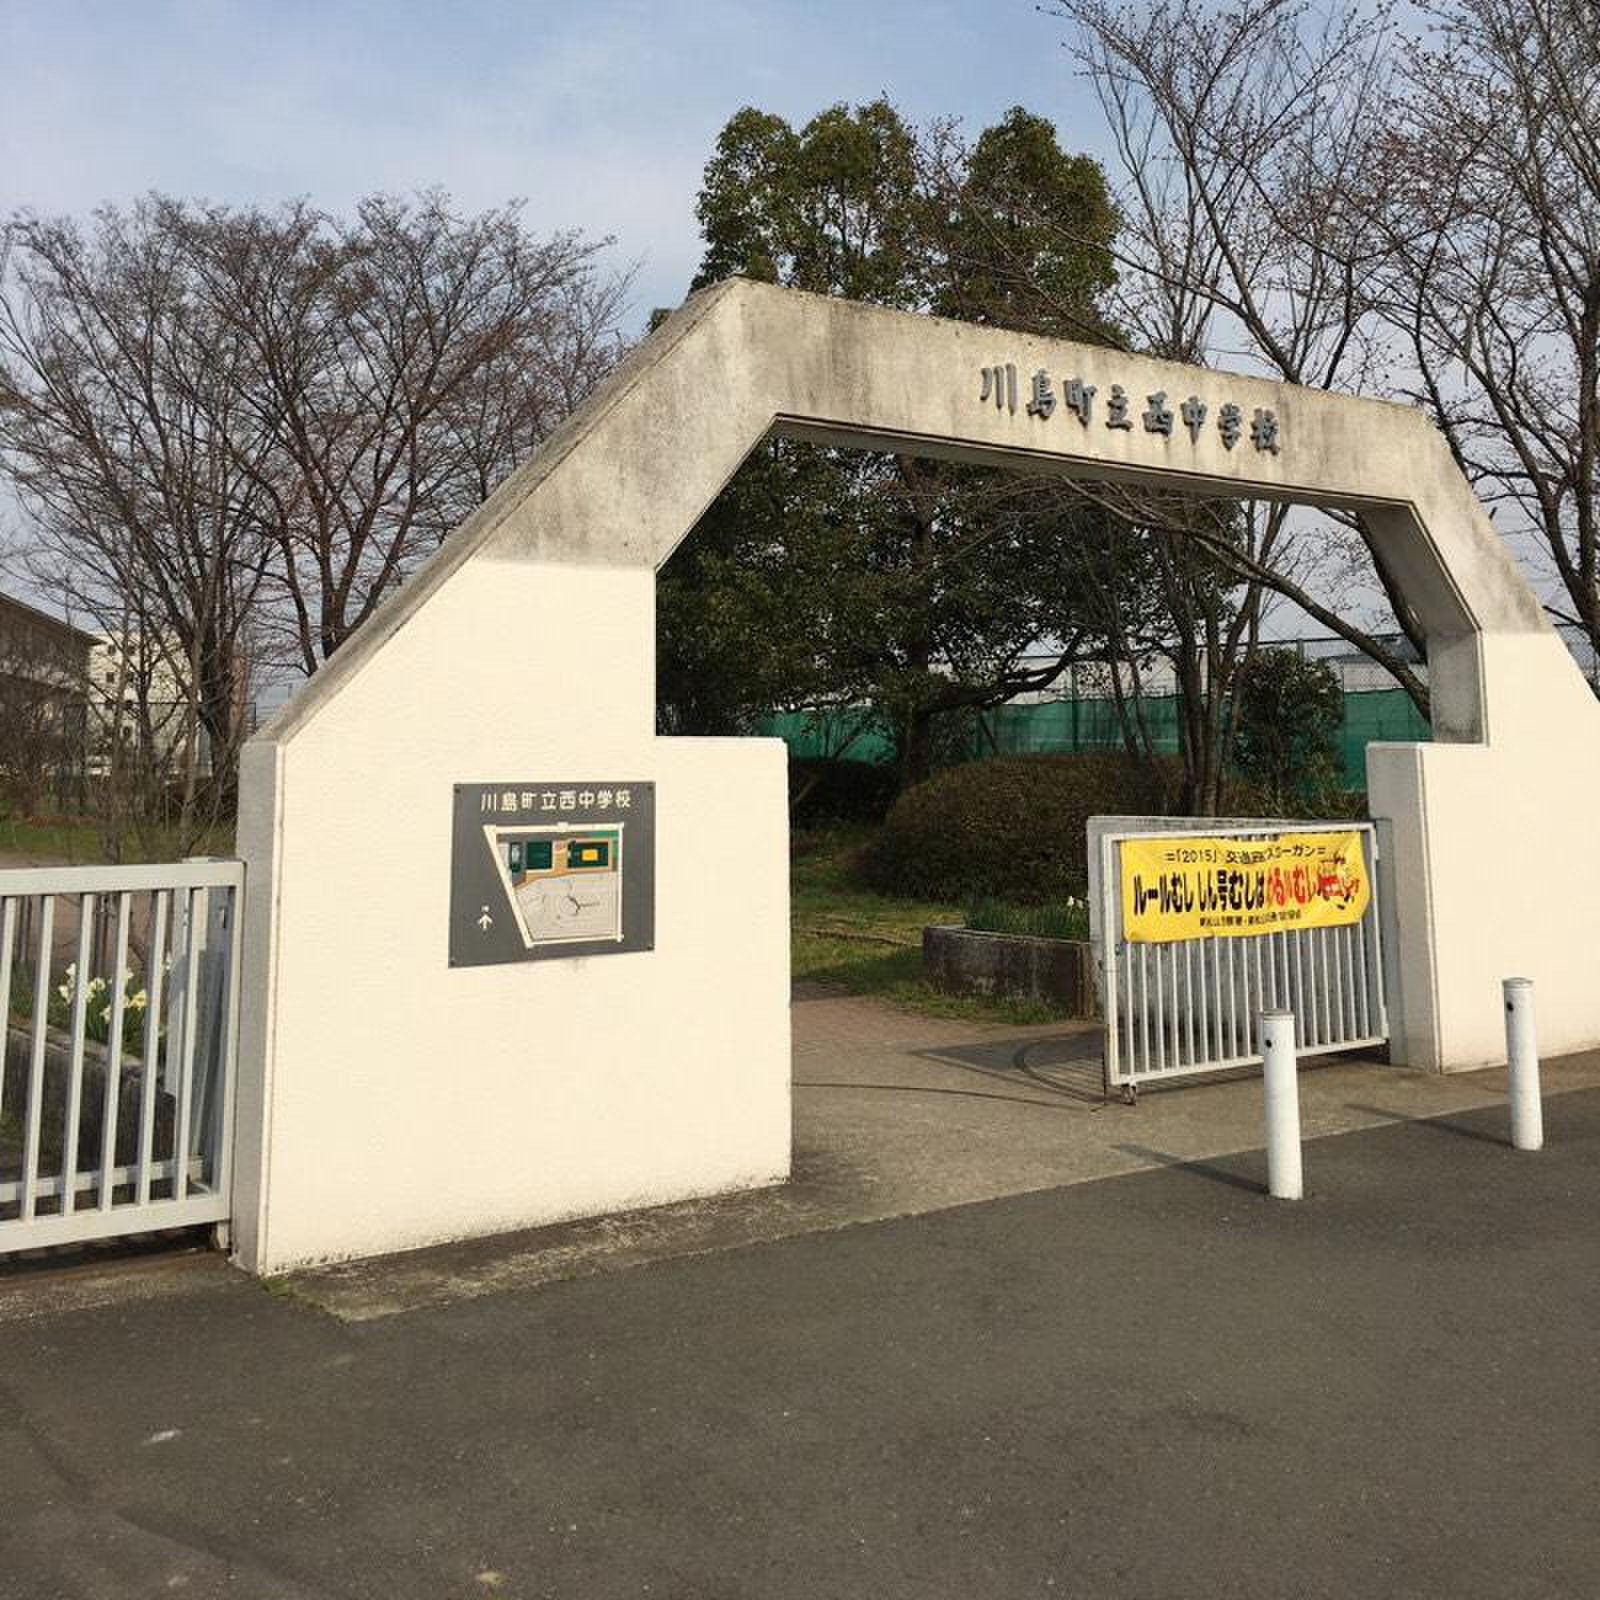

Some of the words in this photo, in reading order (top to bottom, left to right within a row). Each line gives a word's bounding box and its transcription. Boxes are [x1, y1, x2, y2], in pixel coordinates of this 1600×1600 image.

[980, 362, 1281, 456] 川島町立西中学校
[480, 789, 632, 812] 川島町立西中学校
